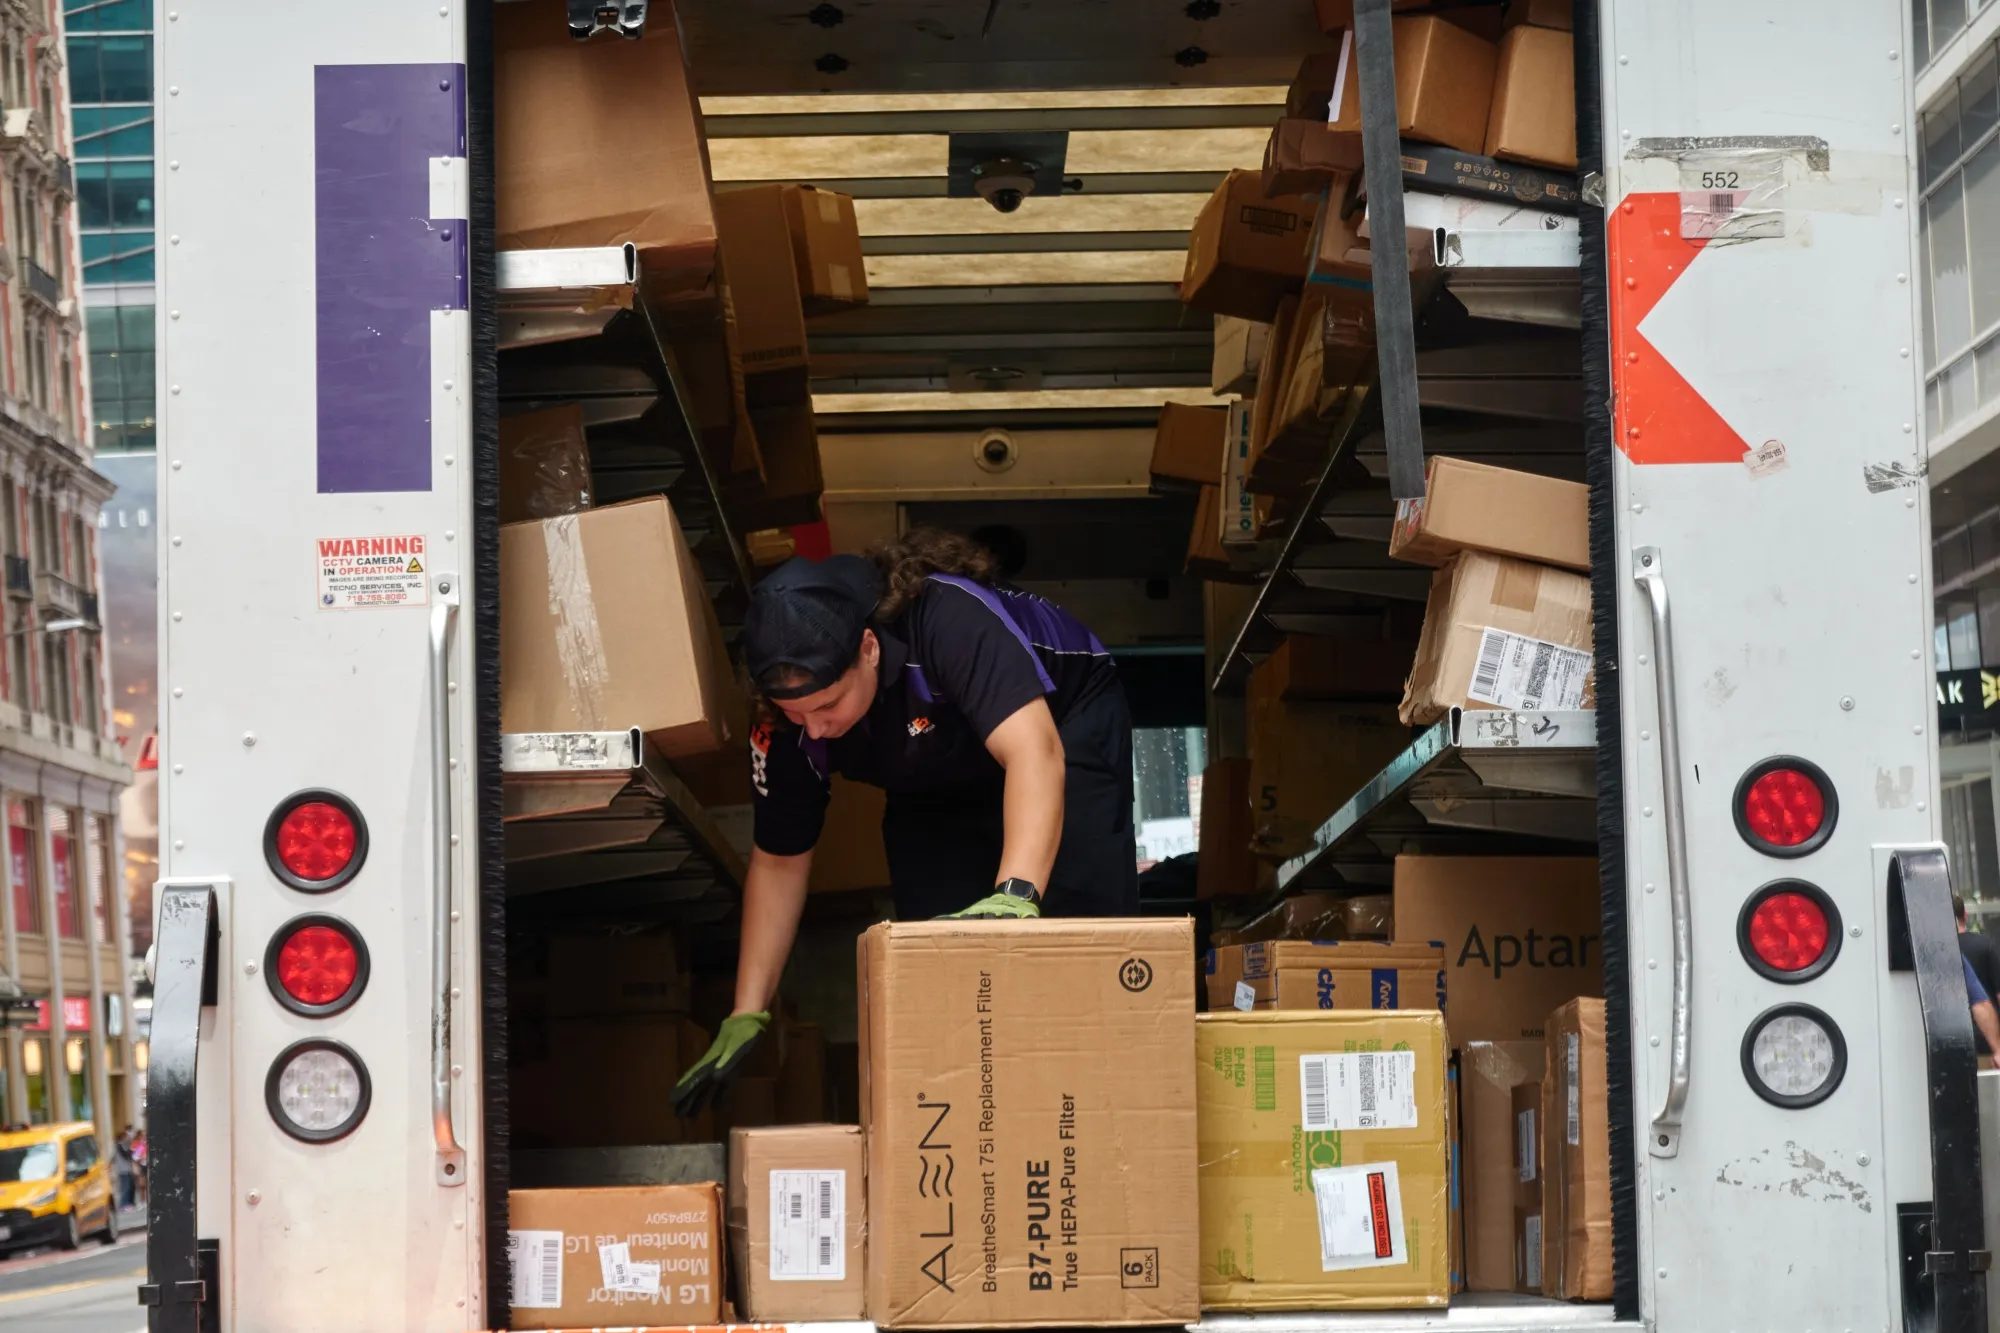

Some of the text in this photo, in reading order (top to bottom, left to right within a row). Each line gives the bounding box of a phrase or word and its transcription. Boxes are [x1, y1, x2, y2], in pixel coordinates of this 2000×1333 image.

[1702, 171, 1739, 188] 552
[319, 537, 423, 557] WARNING
[323, 557, 404, 567] CCTV CAMERA
[324, 566, 403, 576] IN OPERATION
[1261, 786, 1277, 811] 5
[1456, 924, 1599, 979] Aptar
[976, 970, 997, 1293] BreatheSmart 75i Replacement Filter
[1292, 1125, 1303, 1193] PRODUCTS
[1059, 1093, 1078, 1292] True HEPA-Pure Filter
[645, 1210, 708, 1225] 27BP450Y
[1026, 1160, 1052, 1291] B7-PURE
[1371, 1176, 1389, 1255] PACKING LIST ENCLOSED
[565, 1235, 590, 1253] LG
[1124, 1261, 1144, 1276] 6
[1145, 1253, 1154, 1283] PACK
[679, 1283, 710, 1304] LG
